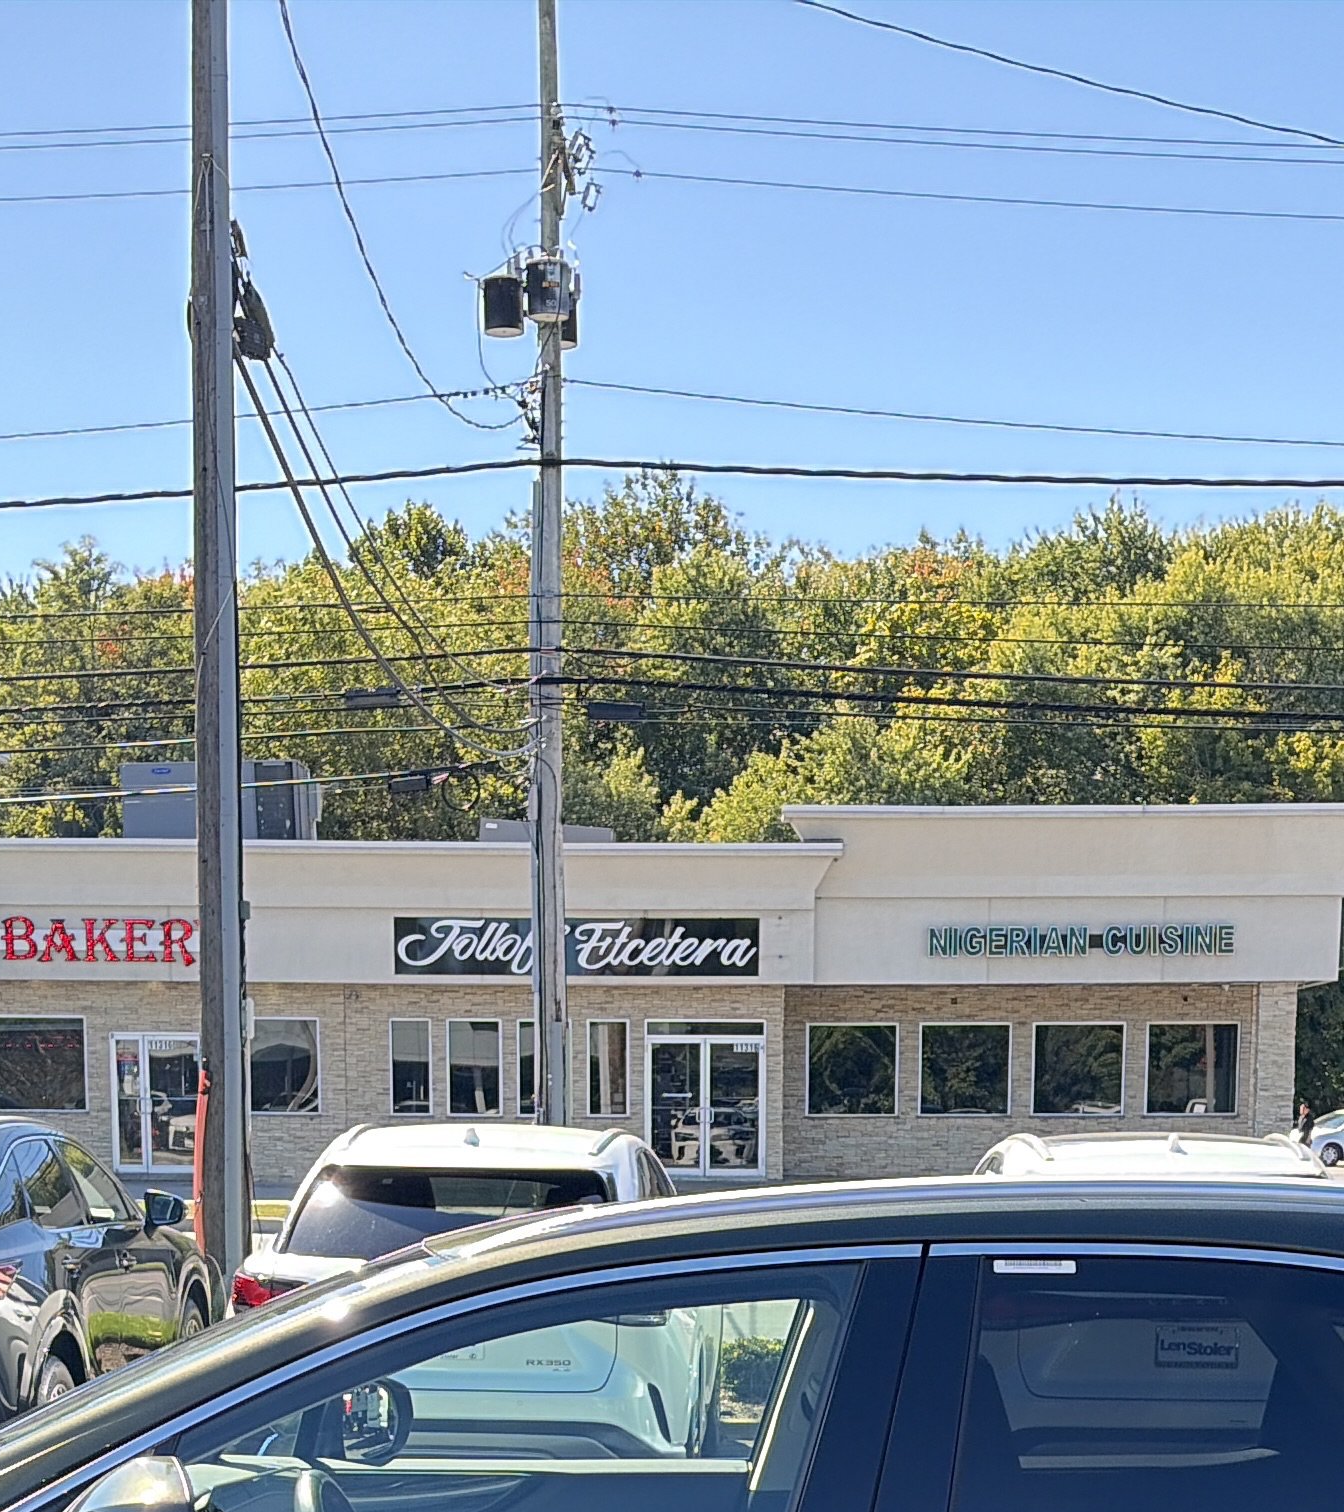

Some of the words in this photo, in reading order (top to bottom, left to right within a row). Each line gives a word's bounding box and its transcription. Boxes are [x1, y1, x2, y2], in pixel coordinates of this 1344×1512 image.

[1, 915, 200, 967] BAKER
[574, 920, 758, 970] Etcetera
[926, 925, 1090, 958] NIGERIAN
[1101, 923, 1236, 957] CUISINE
[526, 1359, 571, 1367] RX350
